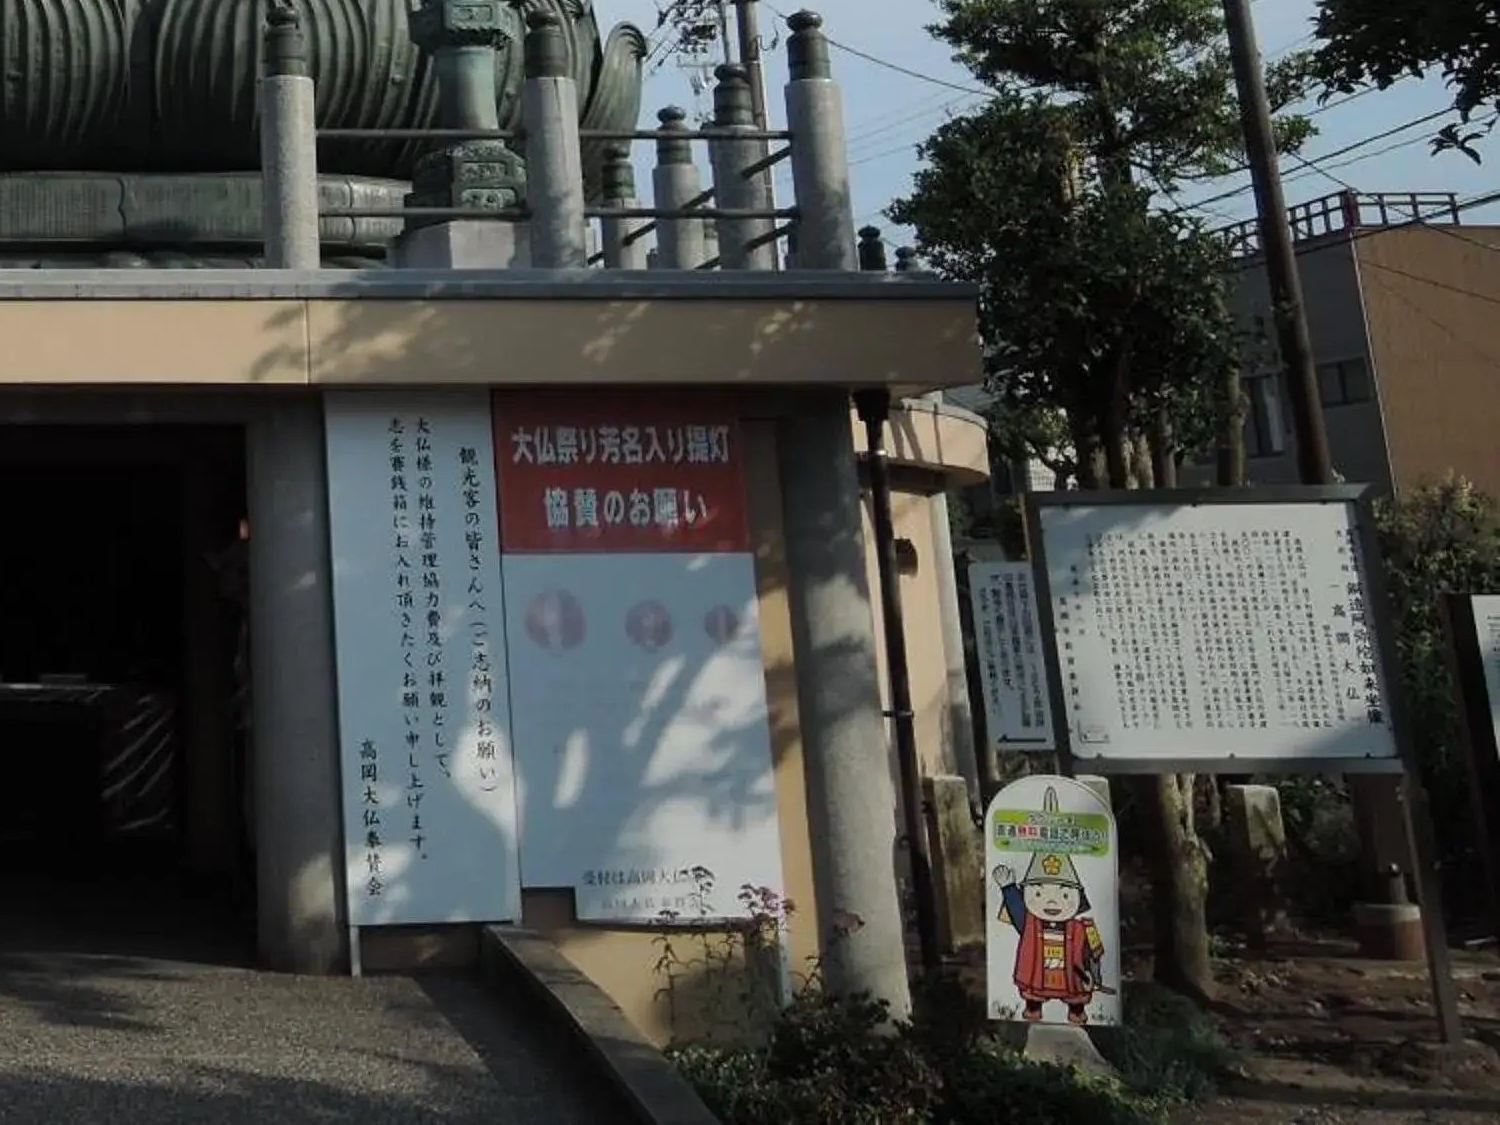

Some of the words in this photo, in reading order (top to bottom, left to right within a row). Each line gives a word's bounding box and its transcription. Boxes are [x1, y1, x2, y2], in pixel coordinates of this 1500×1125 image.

[511, 426, 730, 464] 大仏祭り芳名入り提灯
[544, 487, 709, 528] 協賛のお願い
